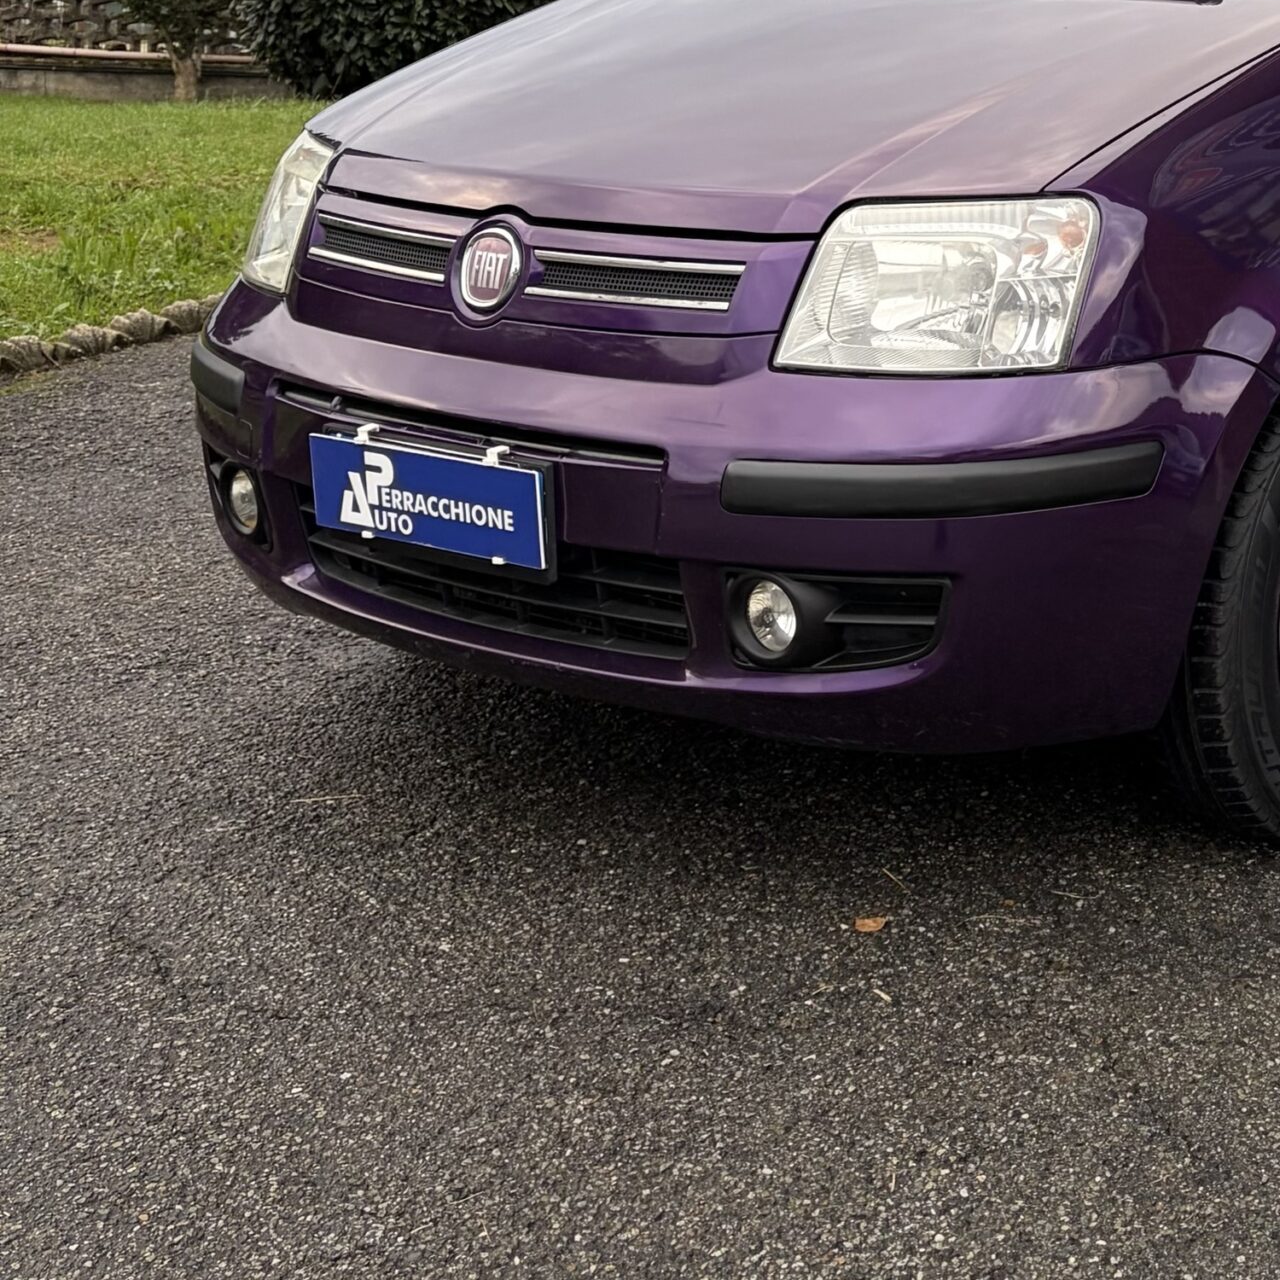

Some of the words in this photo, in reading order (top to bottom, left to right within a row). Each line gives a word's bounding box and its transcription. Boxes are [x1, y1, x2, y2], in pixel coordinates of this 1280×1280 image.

[470, 250, 508, 290] FIAT
[340, 471, 414, 536] AUTO
[363, 450, 515, 532] PERRACCHIONE
